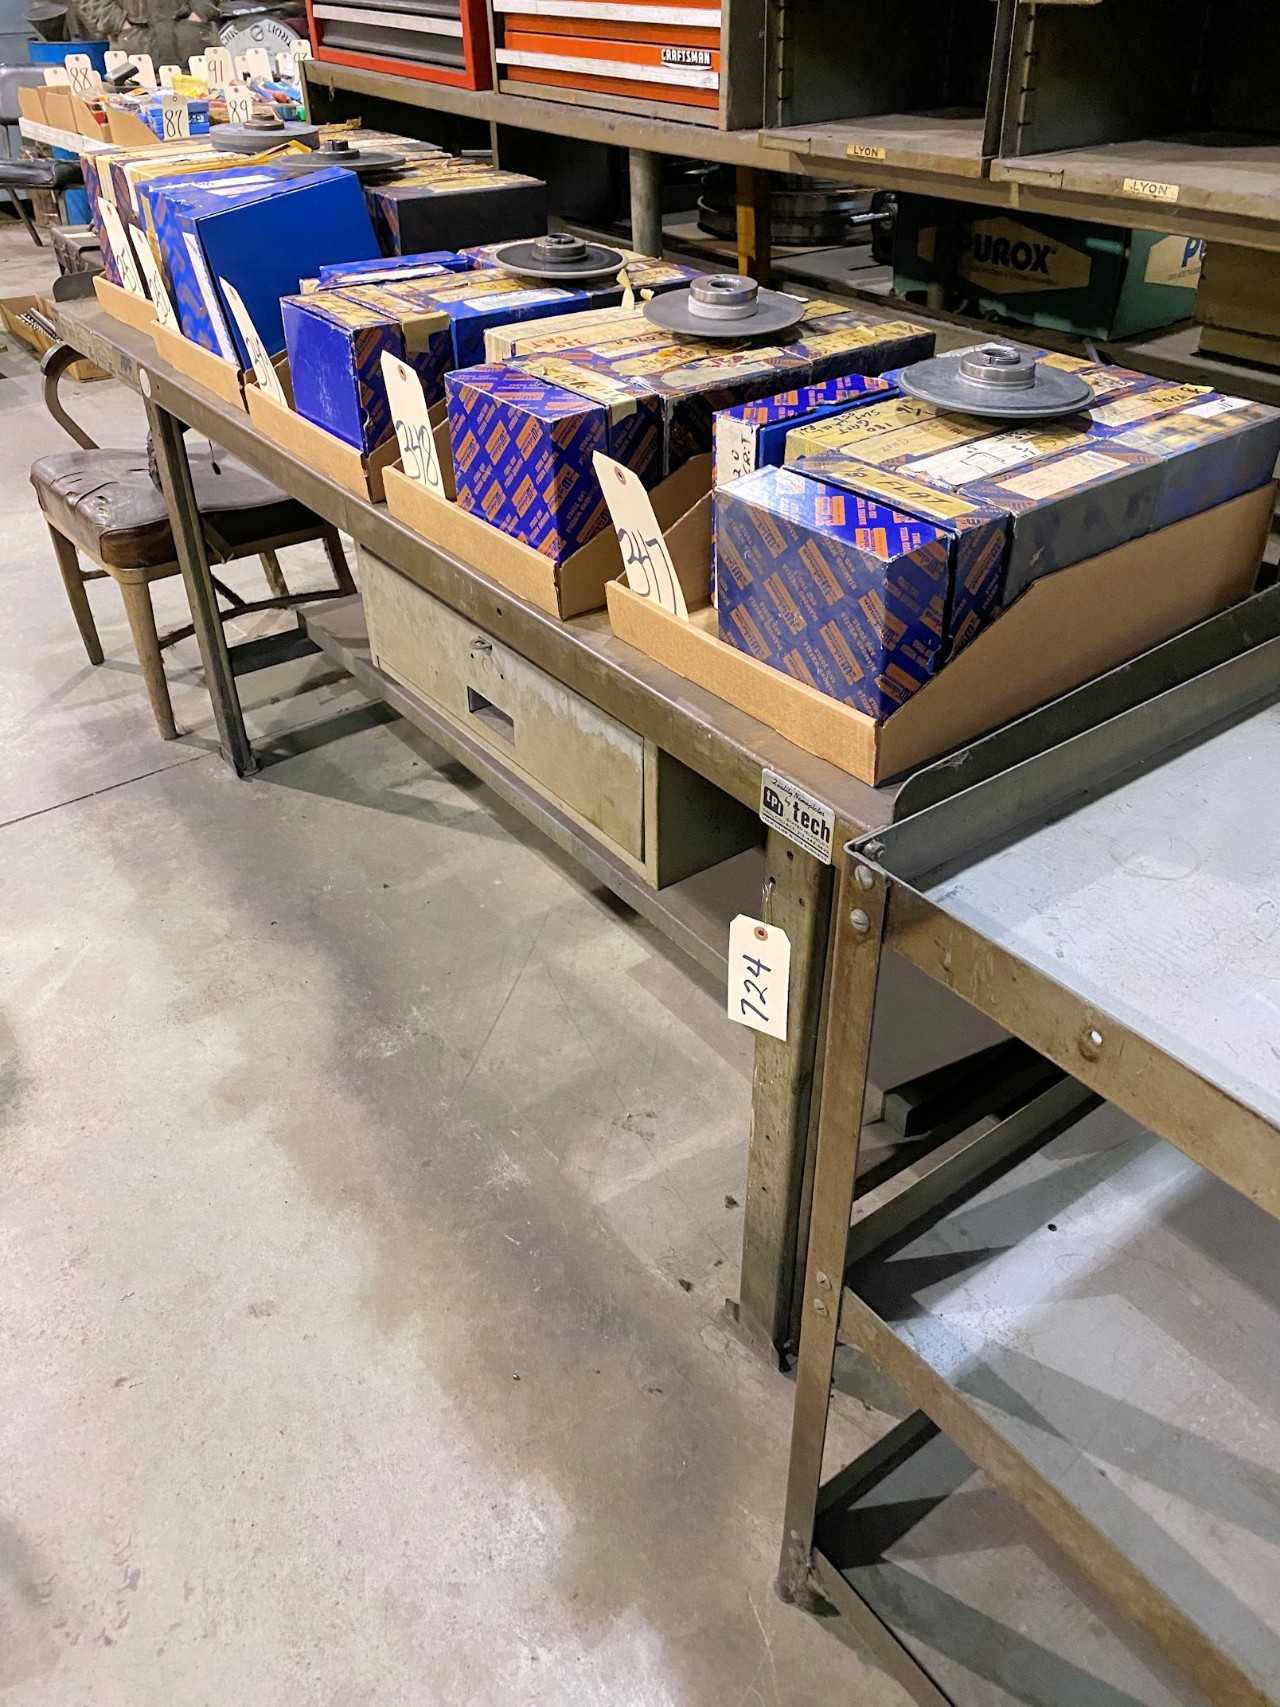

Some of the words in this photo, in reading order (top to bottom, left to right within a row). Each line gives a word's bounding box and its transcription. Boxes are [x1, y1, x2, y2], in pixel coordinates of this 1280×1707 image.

[660, 48, 711, 66] CRAFTSMAN
[70, 67, 93, 95] 88
[208, 60, 224, 83] 91
[165, 110, 183, 137] 87
[229, 100, 250, 123] 89
[853, 145, 878, 158] LYON
[1133, 180, 1168, 195] LYON
[962, 234, 1051, 274] UROX
[395, 419, 439, 486] 348
[617, 527, 678, 616] 347
[792, 801, 831, 844] tech
[740, 953, 772, 1022] 724
